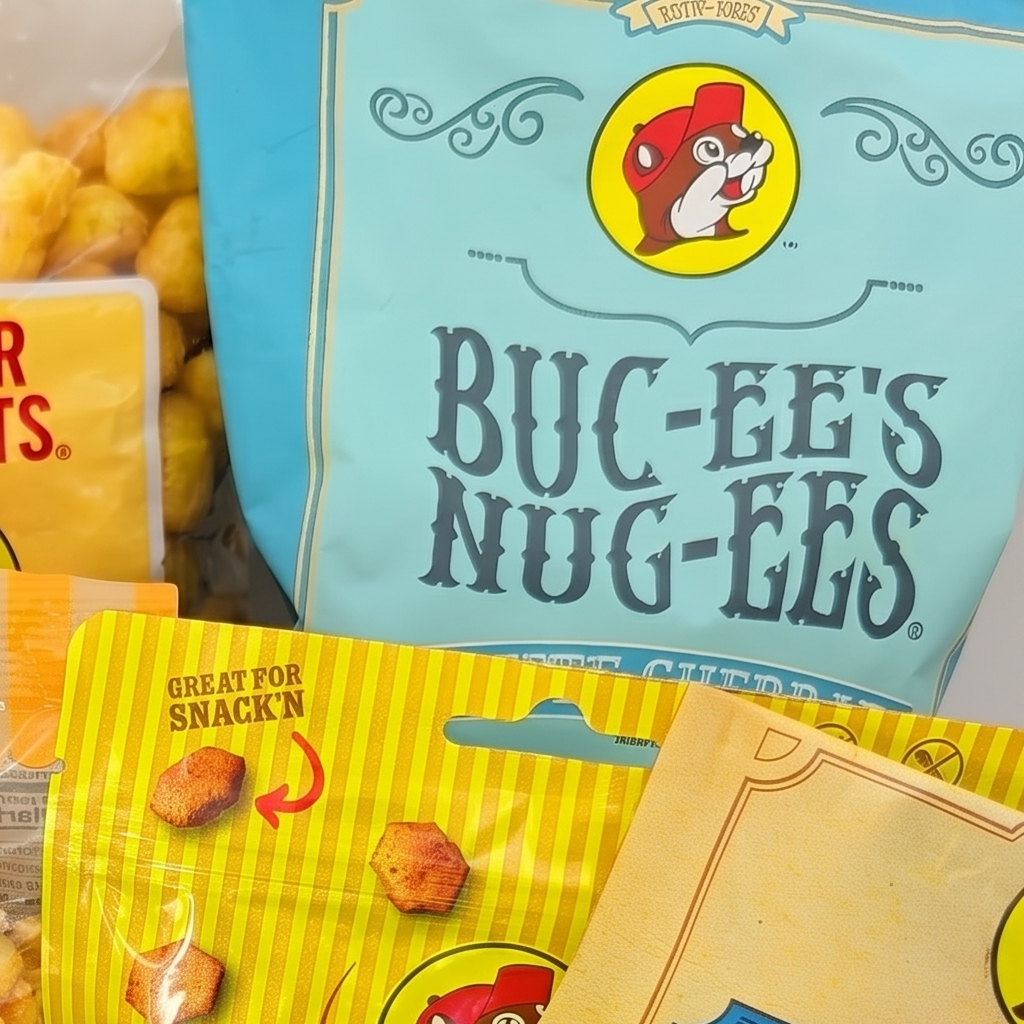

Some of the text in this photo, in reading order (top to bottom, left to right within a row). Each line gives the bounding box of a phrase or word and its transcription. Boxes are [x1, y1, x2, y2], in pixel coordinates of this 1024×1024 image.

[426, 326, 948, 498] BUC-EE'S
[416, 466, 929, 640] NUG-EES
[167, 663, 302, 699] GREAT FOR
[168, 690, 304, 732] SNACK'N
